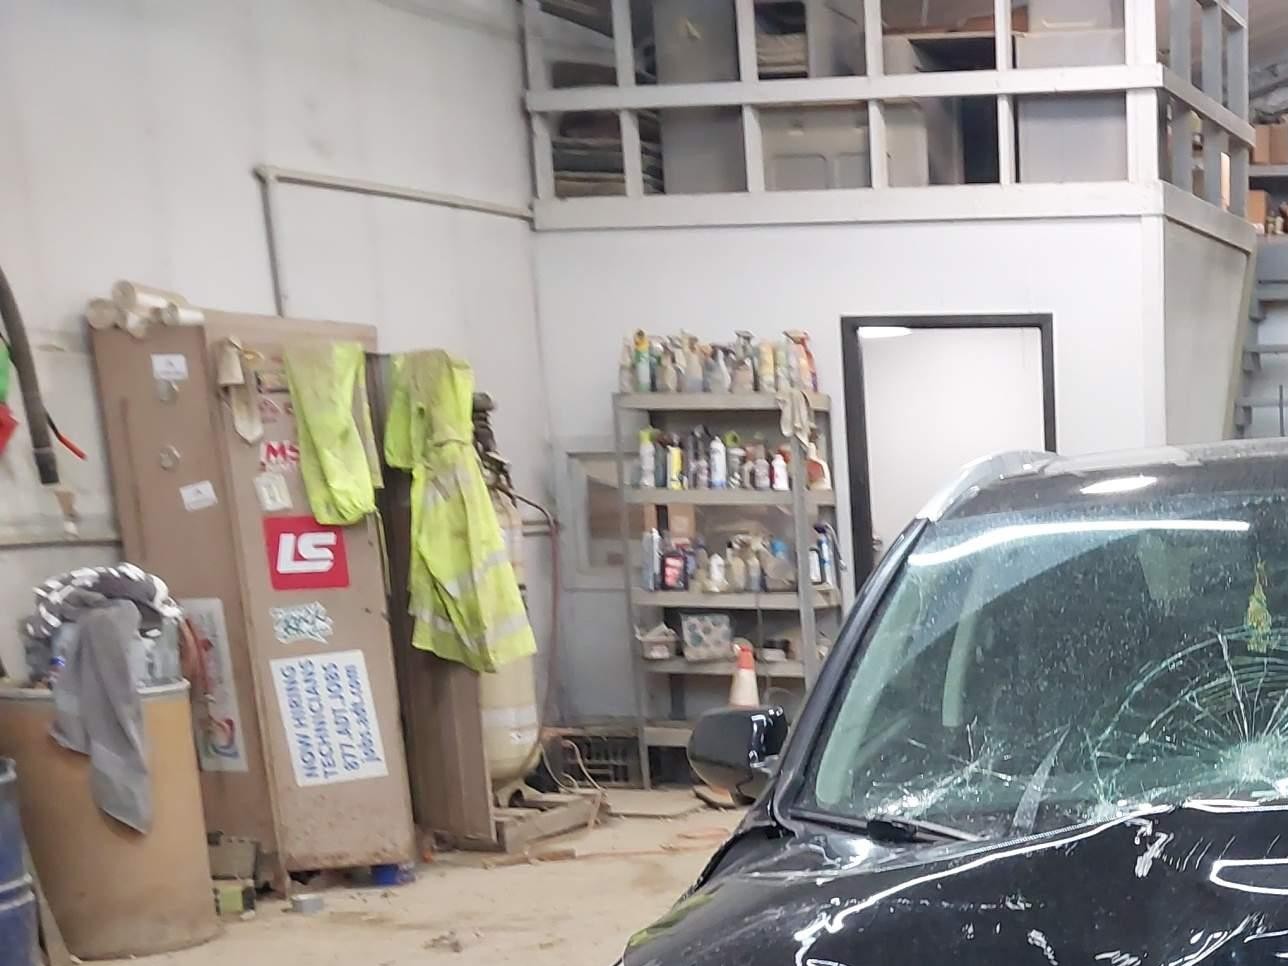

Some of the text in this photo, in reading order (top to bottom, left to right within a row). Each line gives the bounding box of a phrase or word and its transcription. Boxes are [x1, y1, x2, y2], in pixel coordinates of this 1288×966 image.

[276, 531, 337, 574] LS
[280, 665, 308, 729] HIRING
[298, 659, 338, 779] TECHNICIANS
[296, 733, 319, 778] NOW
